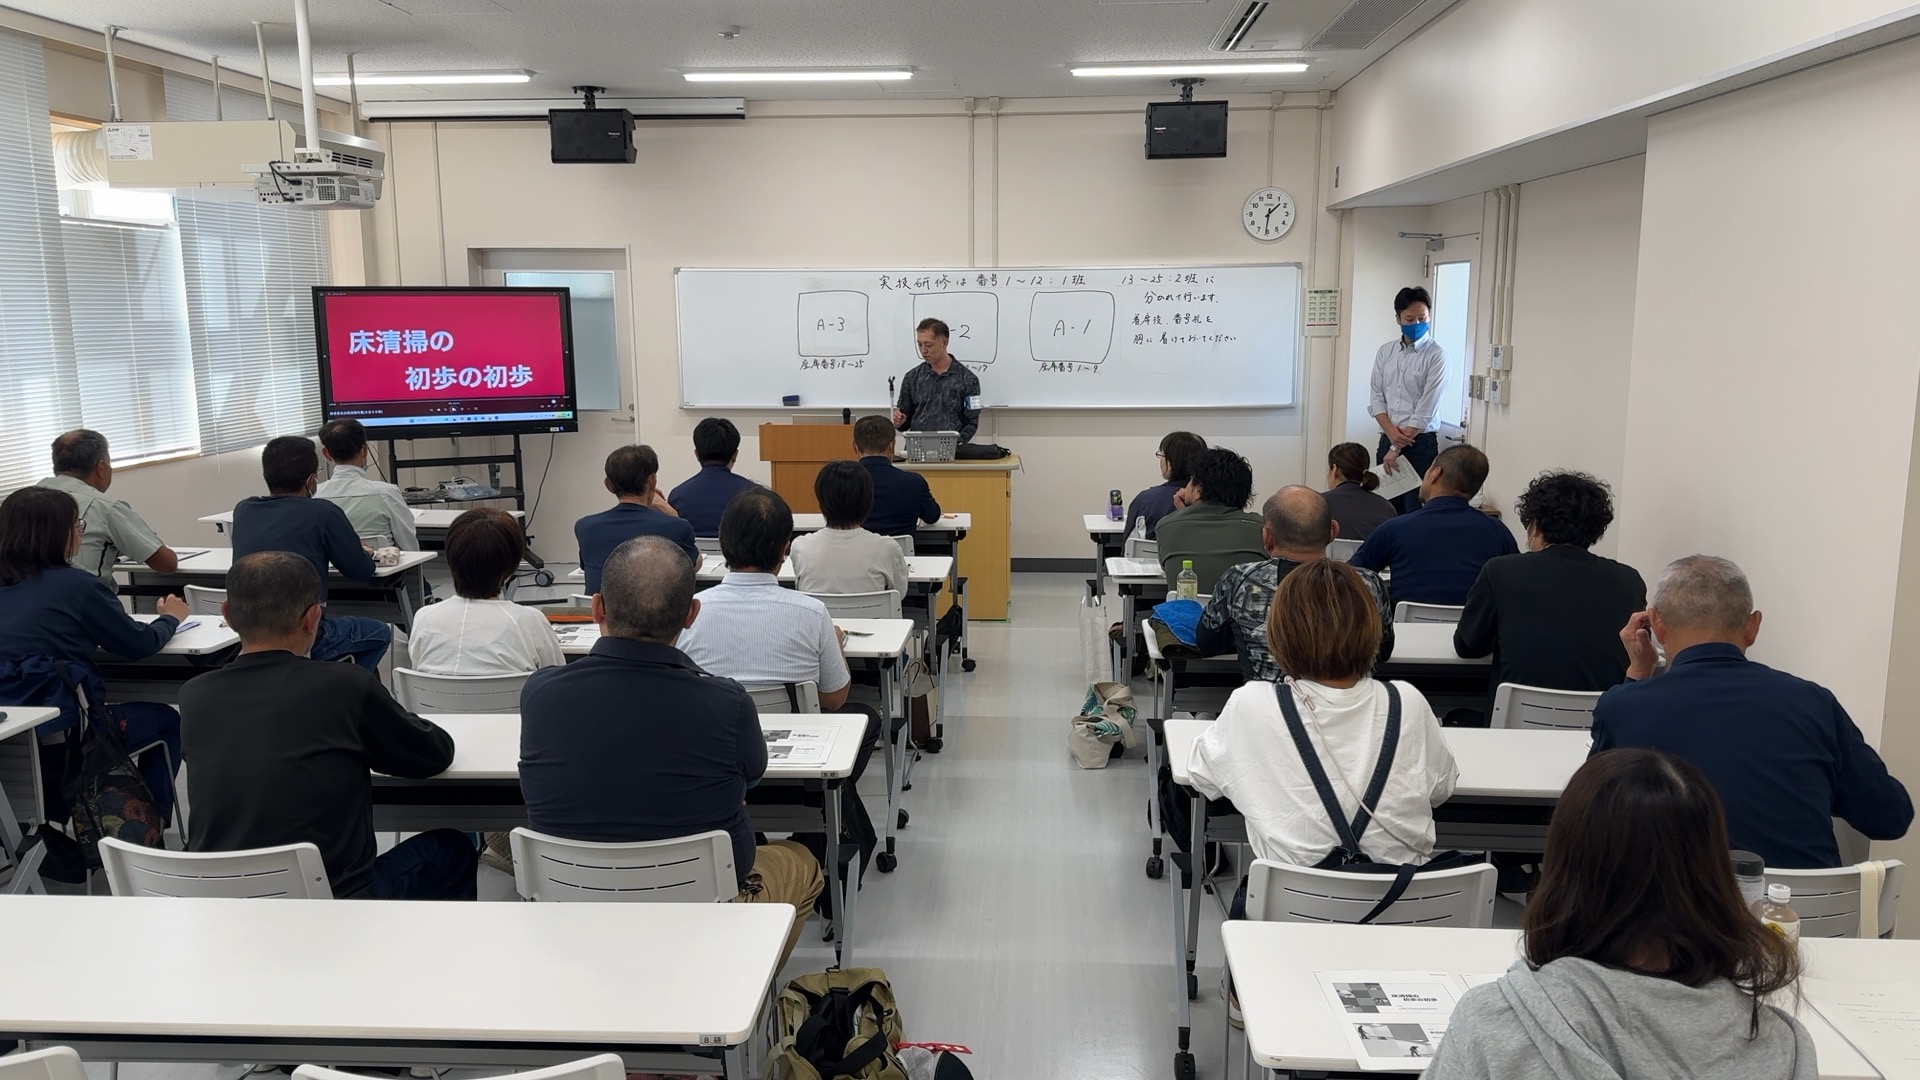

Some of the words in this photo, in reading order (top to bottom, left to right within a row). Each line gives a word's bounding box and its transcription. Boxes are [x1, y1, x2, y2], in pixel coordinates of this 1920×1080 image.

[348, 329, 454, 355] 床清掃の
[405, 365, 533, 391] 初歩の初歩
